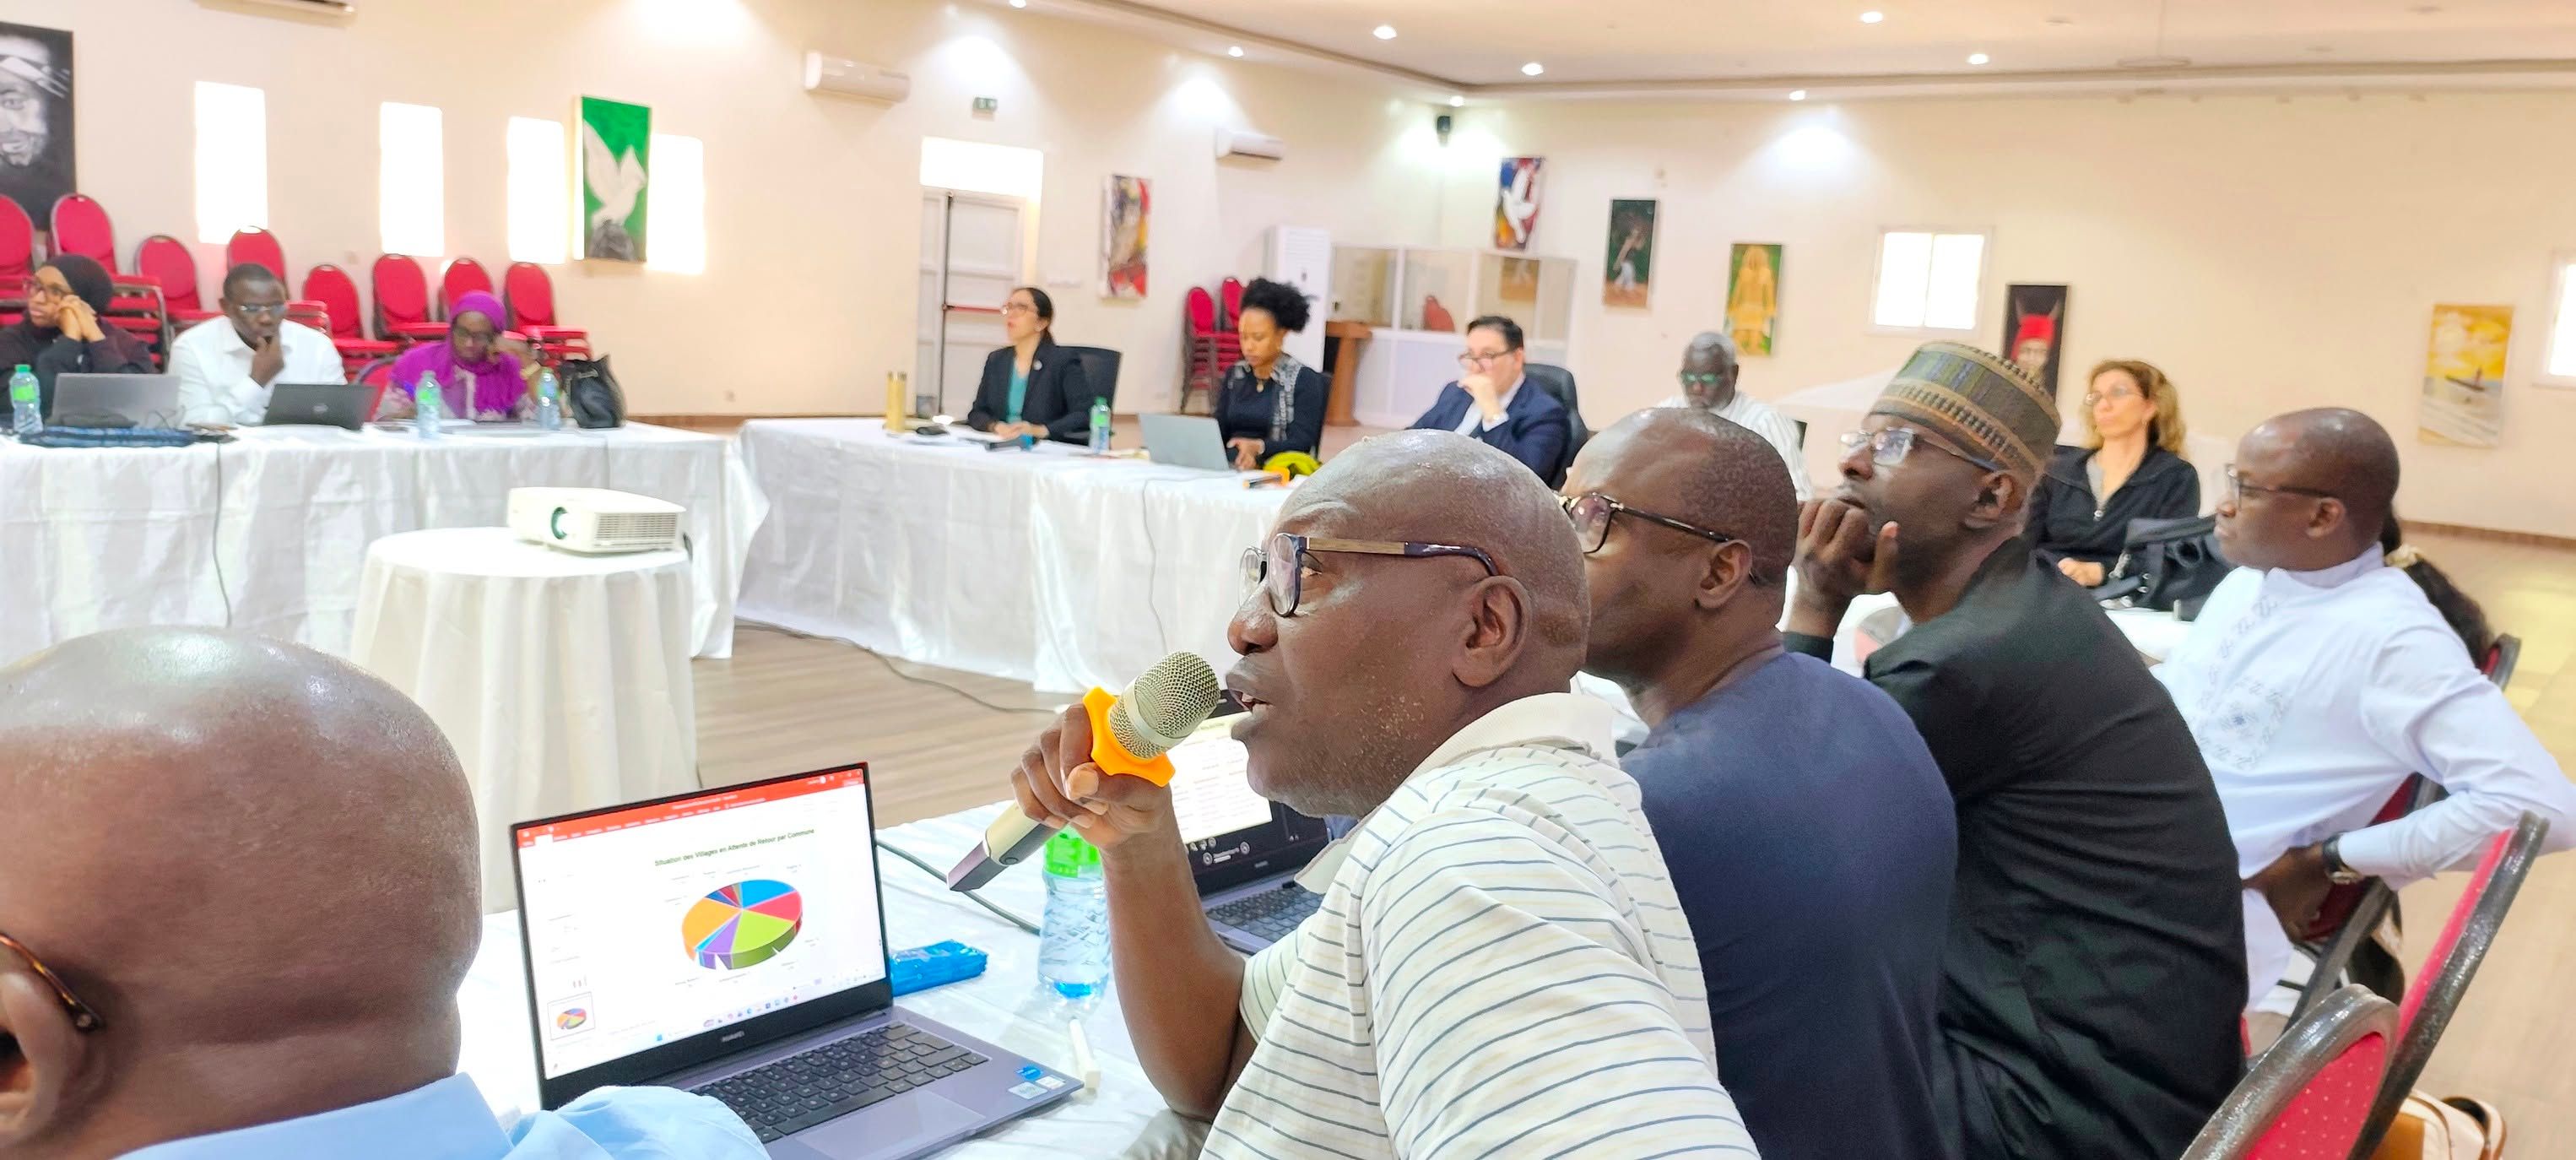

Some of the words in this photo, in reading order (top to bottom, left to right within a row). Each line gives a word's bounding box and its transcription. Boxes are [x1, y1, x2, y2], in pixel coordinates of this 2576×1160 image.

[655, 855, 682, 866] Situation
[695, 848, 718, 858] Villages
[728, 842, 748, 851] Attente
[757, 837, 776, 845] Retour
[777, 834, 786, 843] par
[787, 828, 814, 838] Commune
